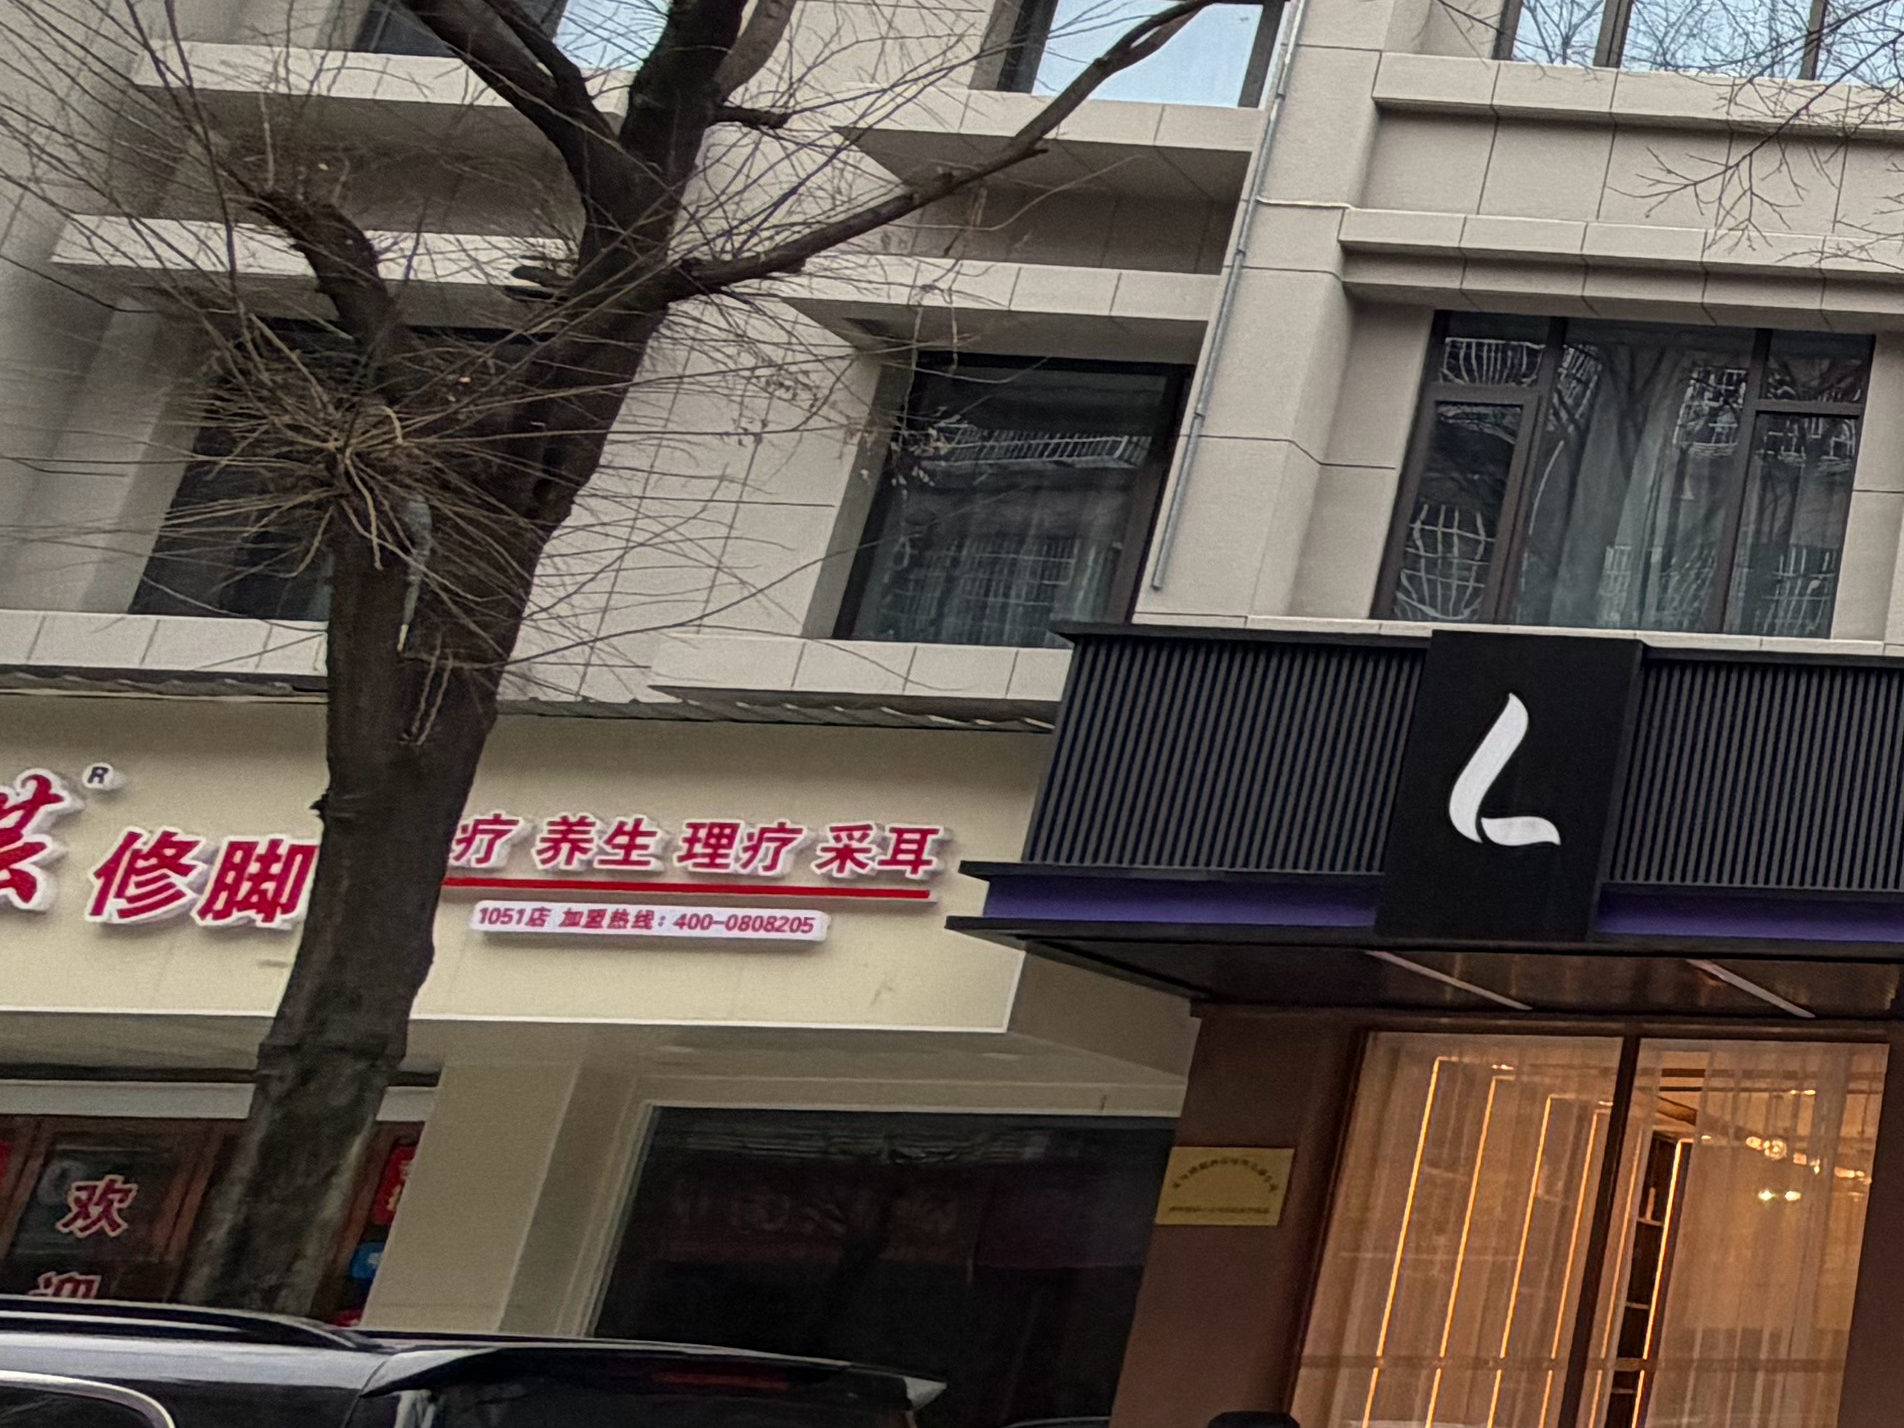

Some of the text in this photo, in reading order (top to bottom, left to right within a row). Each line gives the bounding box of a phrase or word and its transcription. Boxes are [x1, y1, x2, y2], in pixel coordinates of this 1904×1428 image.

[538, 815, 660, 870] 养生
[678, 822, 804, 872] 理疗
[817, 823, 940, 875] 采耳
[90, 831, 319, 924] 修脚
[478, 906, 549, 927] 1051店
